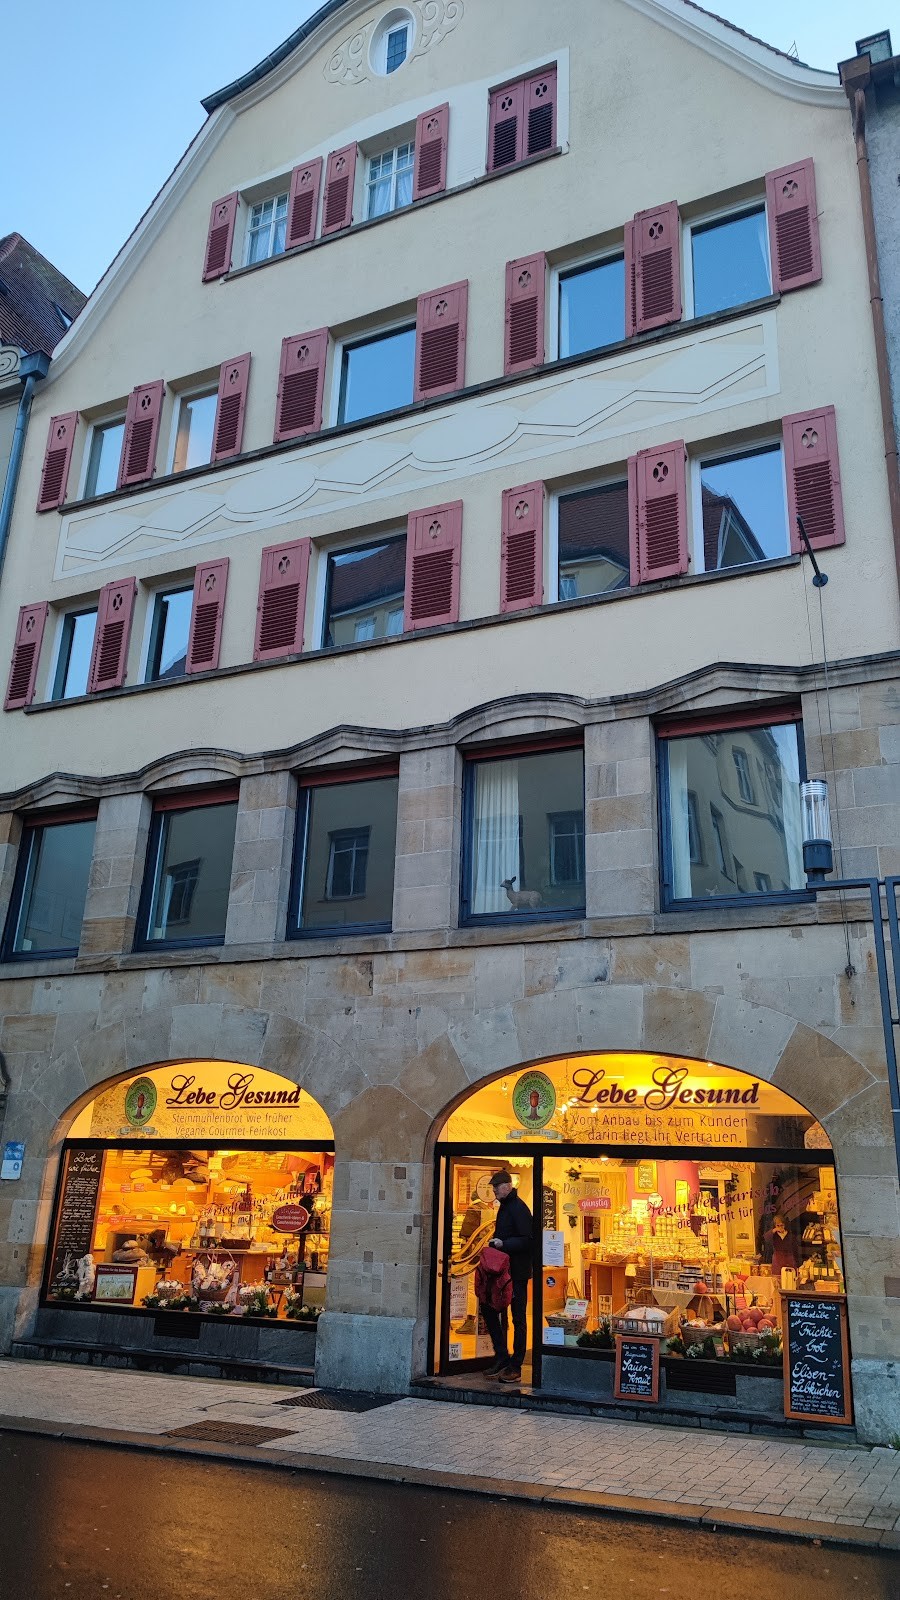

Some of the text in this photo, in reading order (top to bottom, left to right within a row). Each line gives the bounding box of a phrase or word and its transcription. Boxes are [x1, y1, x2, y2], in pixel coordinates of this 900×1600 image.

[166, 1072, 301, 1110] Lebe Gesund
[570, 1066, 760, 1110] Lebe Gesund
[246, 1113, 262, 1123] wie
[572, 1114, 749, 1128] Vom Anbau bis zum Kunden
[587, 1128, 618, 1141] darin
[675, 1131, 742, 1143] Vertrauen.
[73, 1151, 97, 1163] Brot
[563, 1182, 610, 1197] Das Beste
[581, 1198, 609, 1208] günstig
[738, 1206, 754, 1220] für
[792, 1361, 836, 1381] Elisen-
